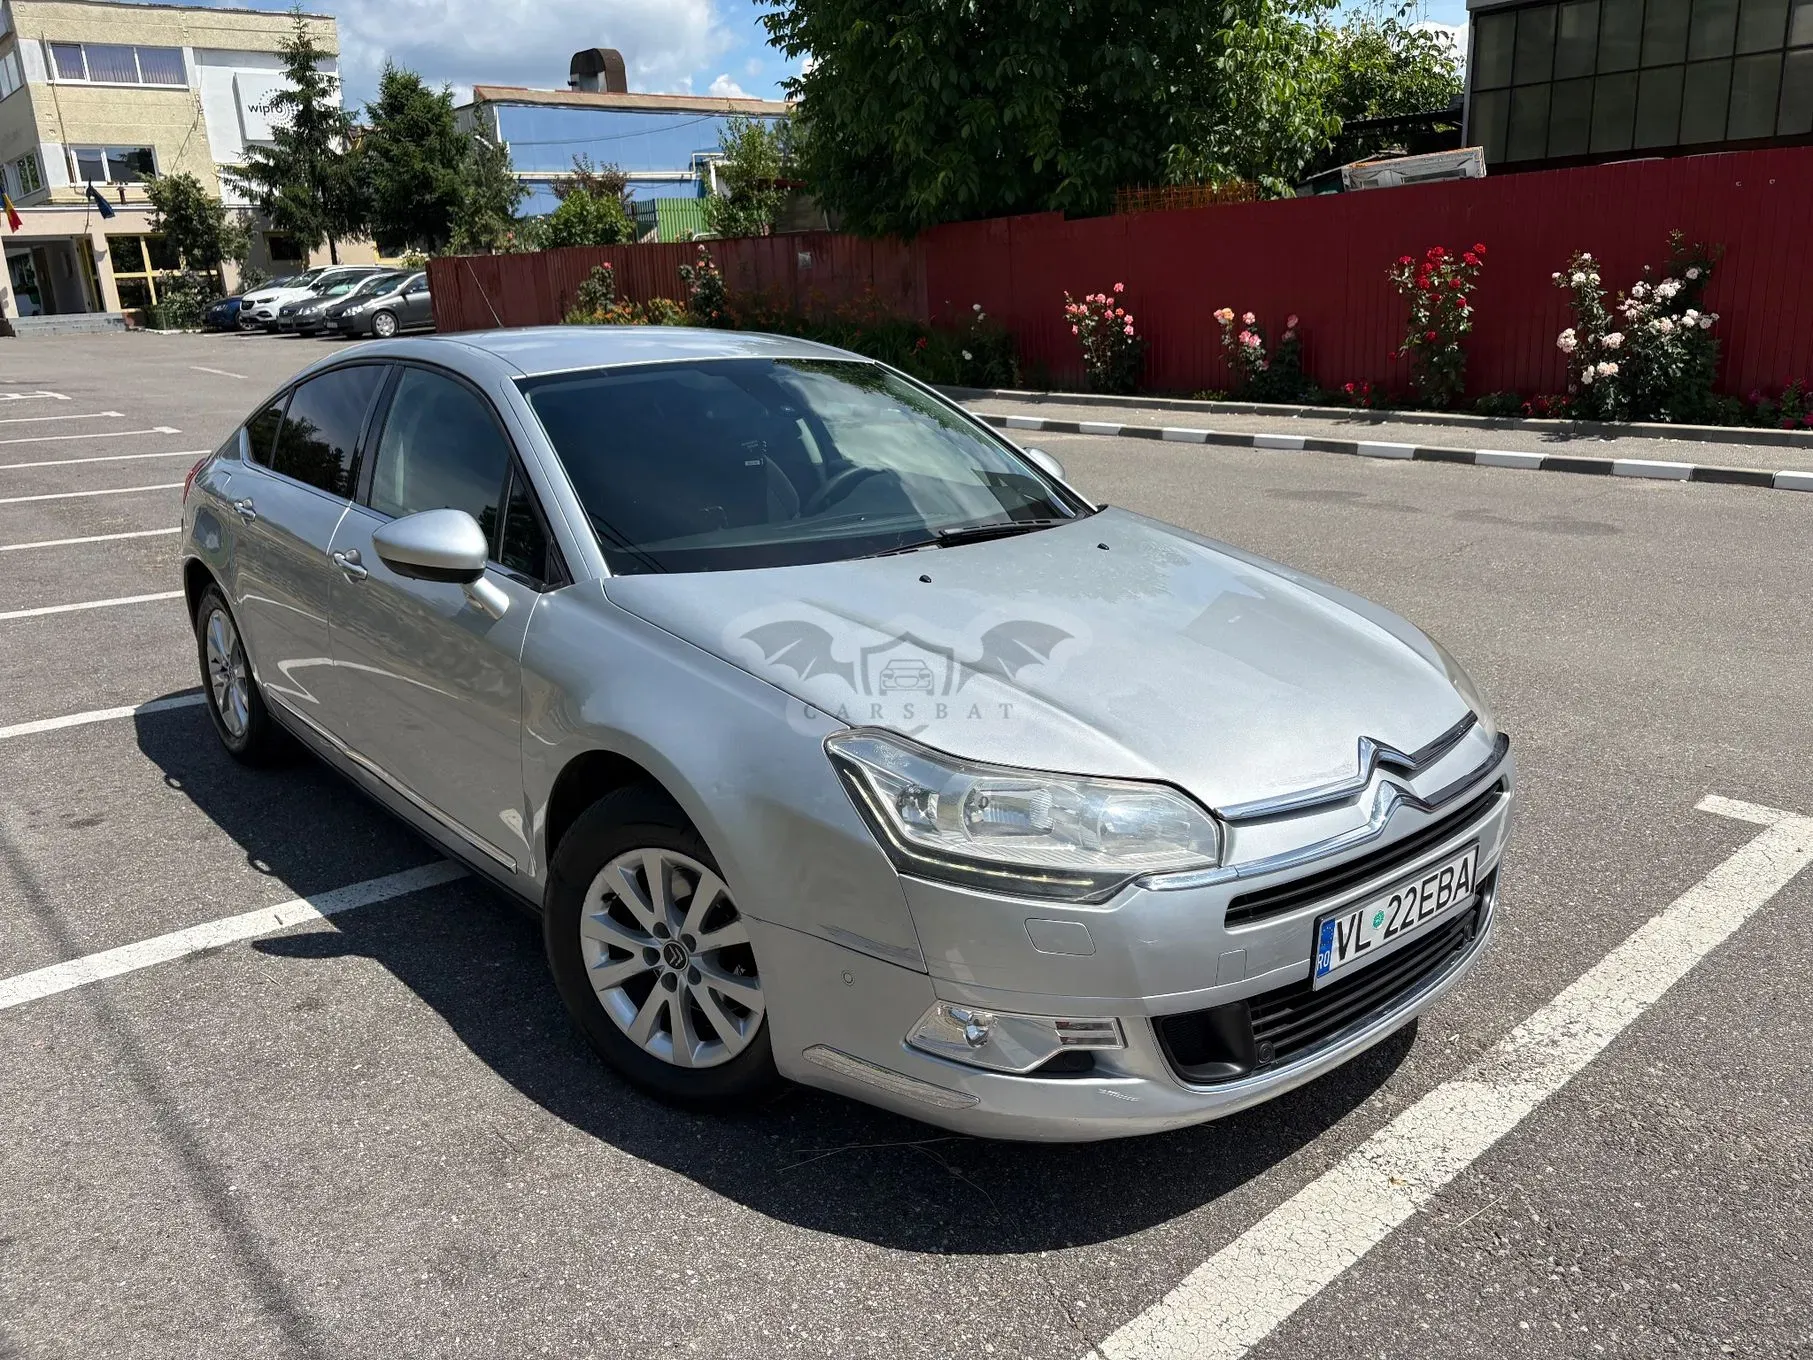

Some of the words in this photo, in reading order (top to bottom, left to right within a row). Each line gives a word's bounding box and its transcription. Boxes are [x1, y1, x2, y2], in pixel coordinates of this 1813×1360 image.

[248, 103, 283, 116] wipro
[1337, 910, 1371, 961] VL
[1383, 857, 1470, 940] 22EBA
[1317, 953, 1330, 971] RO
